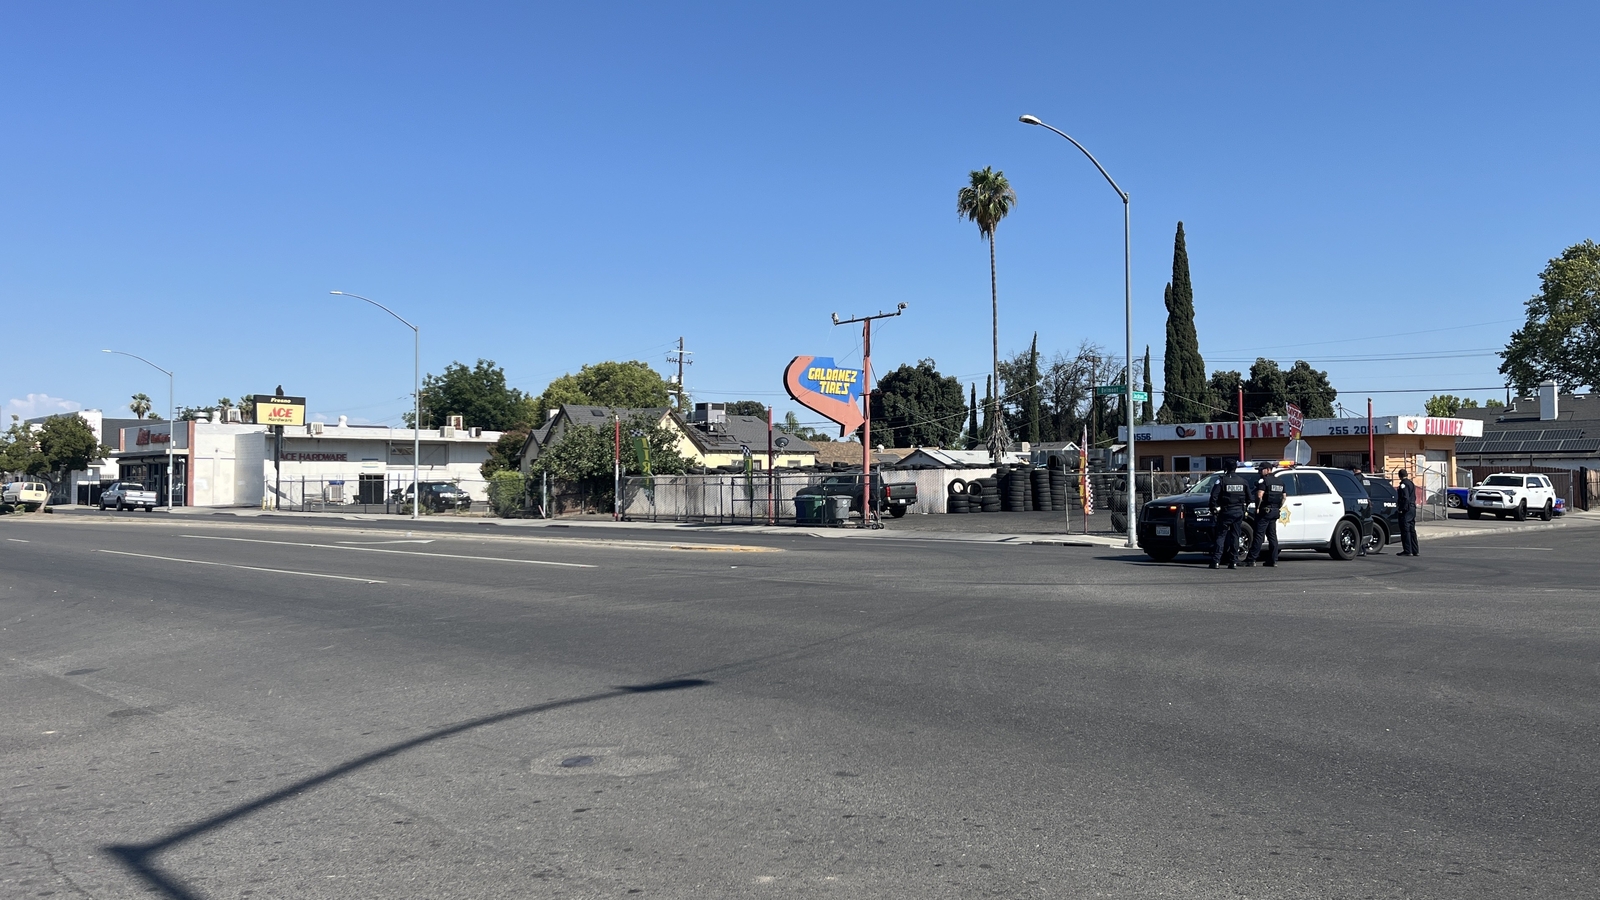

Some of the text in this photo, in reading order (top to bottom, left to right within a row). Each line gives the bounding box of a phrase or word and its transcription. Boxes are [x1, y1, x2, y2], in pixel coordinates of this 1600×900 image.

[808, 367, 858, 383] GALDAMEZ
[819, 381, 850, 395] TIRES
[268, 407, 293, 418] ACE
[1205, 422, 1285, 439] GALAME
[1328, 426, 1349, 435] 255
[1425, 418, 1464, 437] GALDAMEZ
[280, 452, 347, 461] ACE HARDWARE
